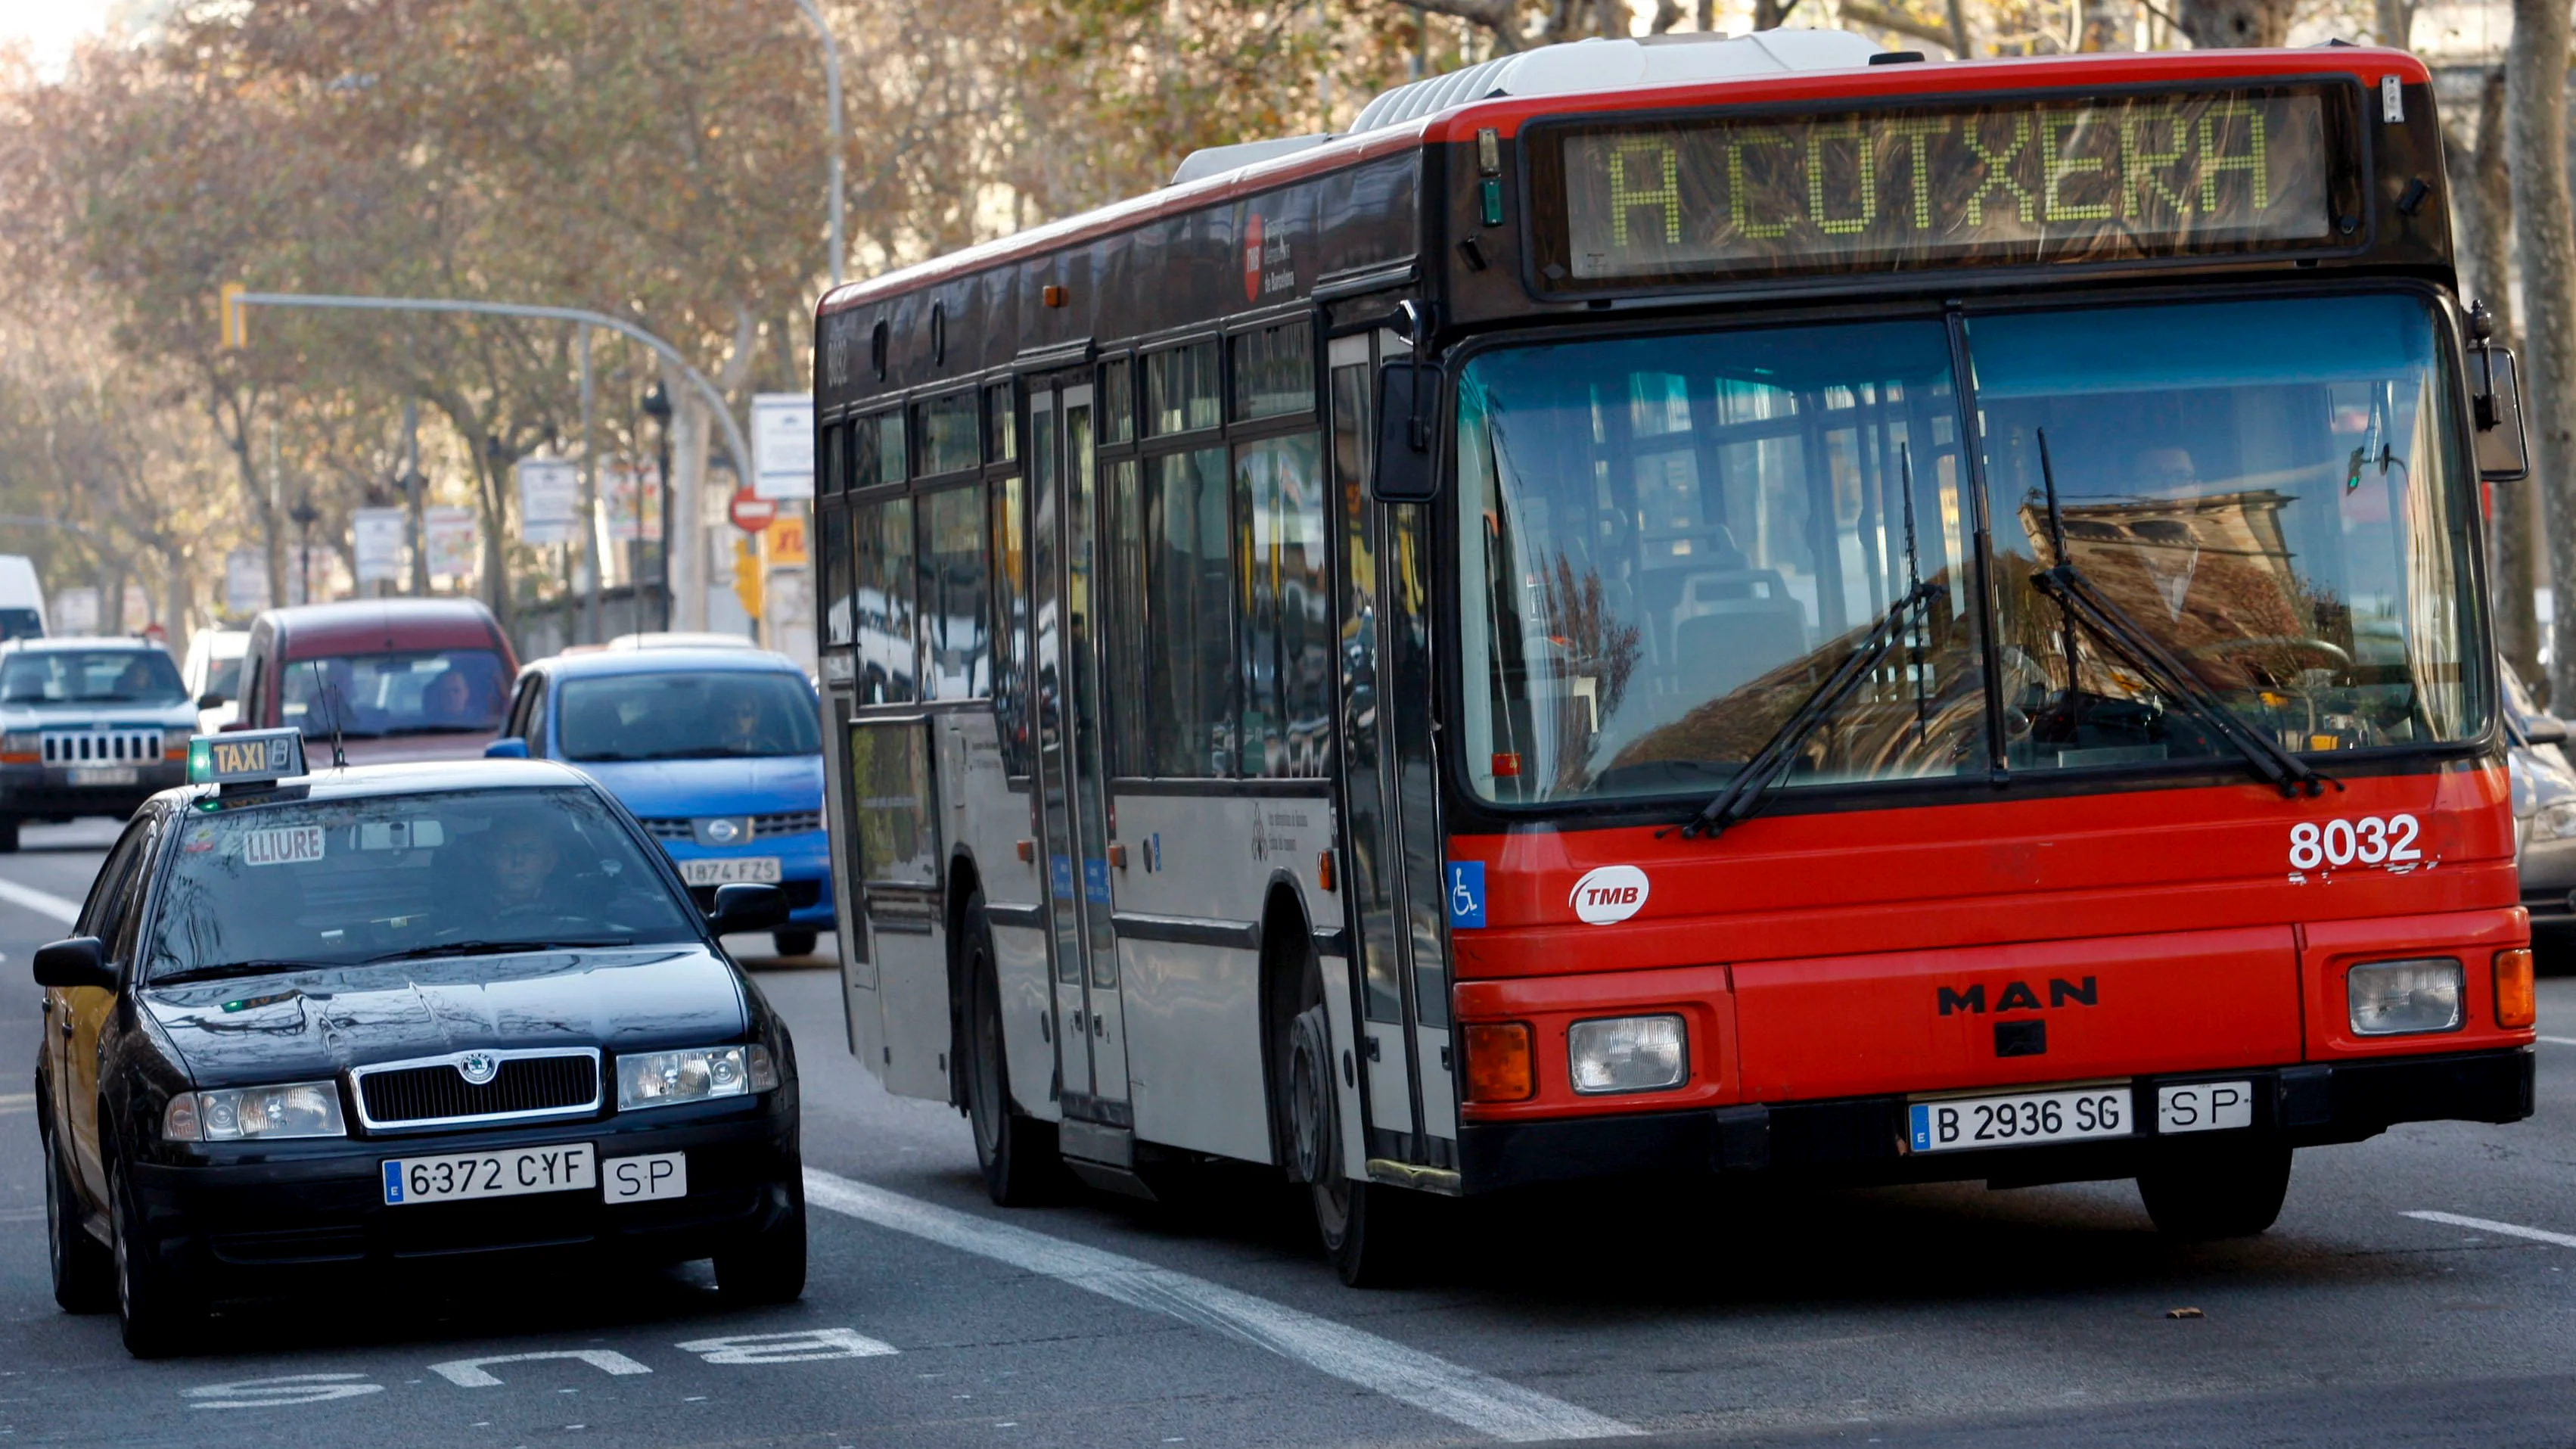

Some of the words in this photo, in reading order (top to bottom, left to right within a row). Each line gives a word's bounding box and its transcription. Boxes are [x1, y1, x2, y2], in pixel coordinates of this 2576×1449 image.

[1609, 135, 1680, 247] A
[1728, 103, 2268, 238] COTXERA
[213, 742, 265, 773] TAXI
[247, 829, 320, 862] LLIURE
[2289, 813, 2421, 869] 8032
[686, 862, 732, 882] 1874
[738, 860, 775, 879] FZS
[1586, 886, 1639, 906] TMB
[1937, 975, 2097, 1016] MAN
[1917, 1132, 1925, 1143] E
[1937, 1107, 1960, 1143] B
[1972, 1099, 2063, 1141] 2936
[2075, 1096, 2120, 1131] SG
[390, 1186, 399, 1196] E
[409, 1158, 503, 1196] 6372
[517, 1150, 583, 1186] CYF
[179, 1327, 900, 1409] BUS
